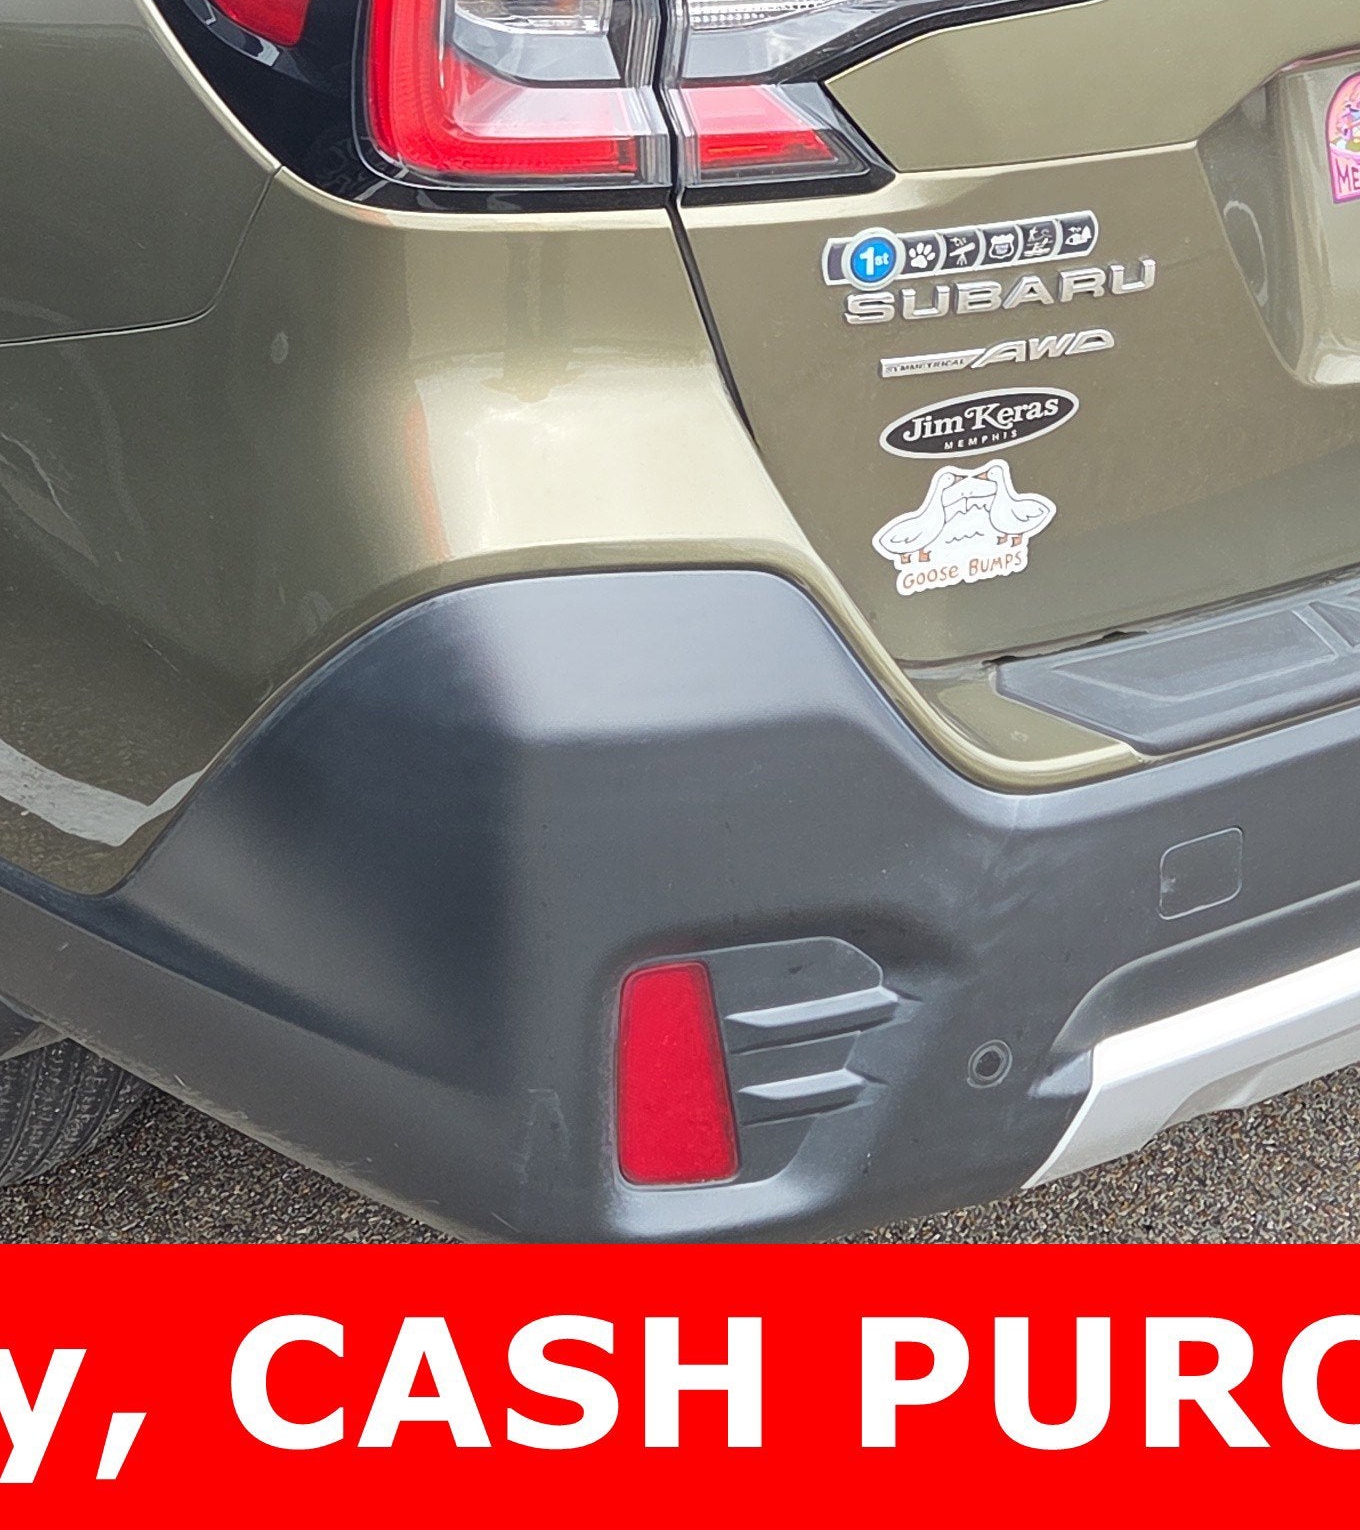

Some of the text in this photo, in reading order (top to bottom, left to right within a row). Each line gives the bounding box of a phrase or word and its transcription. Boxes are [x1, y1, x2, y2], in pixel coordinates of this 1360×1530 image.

[858, 246, 890, 276] 1st
[843, 258, 1156, 325] SUBARU
[969, 328, 1116, 369] AWD
[902, 398, 1059, 442] Jim Keras
[943, 428, 1019, 450] MEMPHIS
[968, 551, 1022, 577] BUMPS
